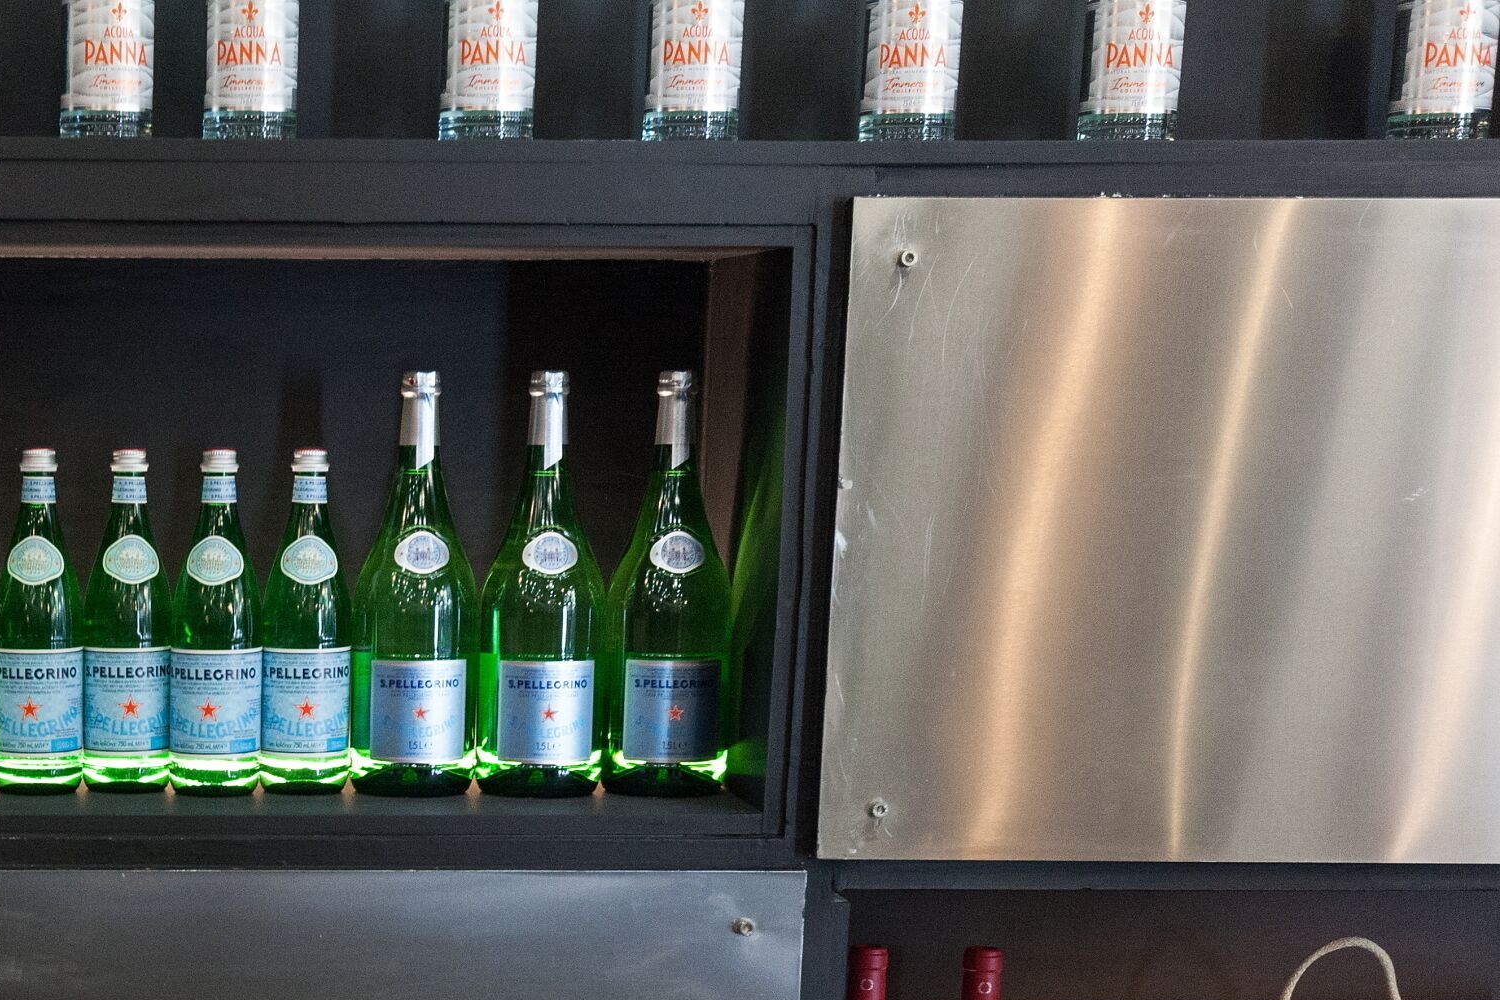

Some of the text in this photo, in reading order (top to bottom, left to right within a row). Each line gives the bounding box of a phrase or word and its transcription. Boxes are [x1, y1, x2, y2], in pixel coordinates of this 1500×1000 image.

[104, 27, 134, 38] ACQUA
[234, 27, 265, 37] ACQUA
[1129, 30, 1161, 40] ACQU
[84, 39, 148, 65] PANNA
[217, 40, 281, 65] PANNA
[461, 40, 526, 65] PANNA
[663, 40, 730, 65] PANNA
[879, 44, 946, 68] PANNA
[1107, 43, 1173, 68] PANNA
[1424, 42, 1492, 68] PANNA
[170, 667, 256, 680] .PELLEGRINO
[263, 665, 349, 680] S.PELLEGRINO
[380, 679, 459, 689] S.PELLEGRINO
[508, 679, 587, 689] S.PELLEGRINO
